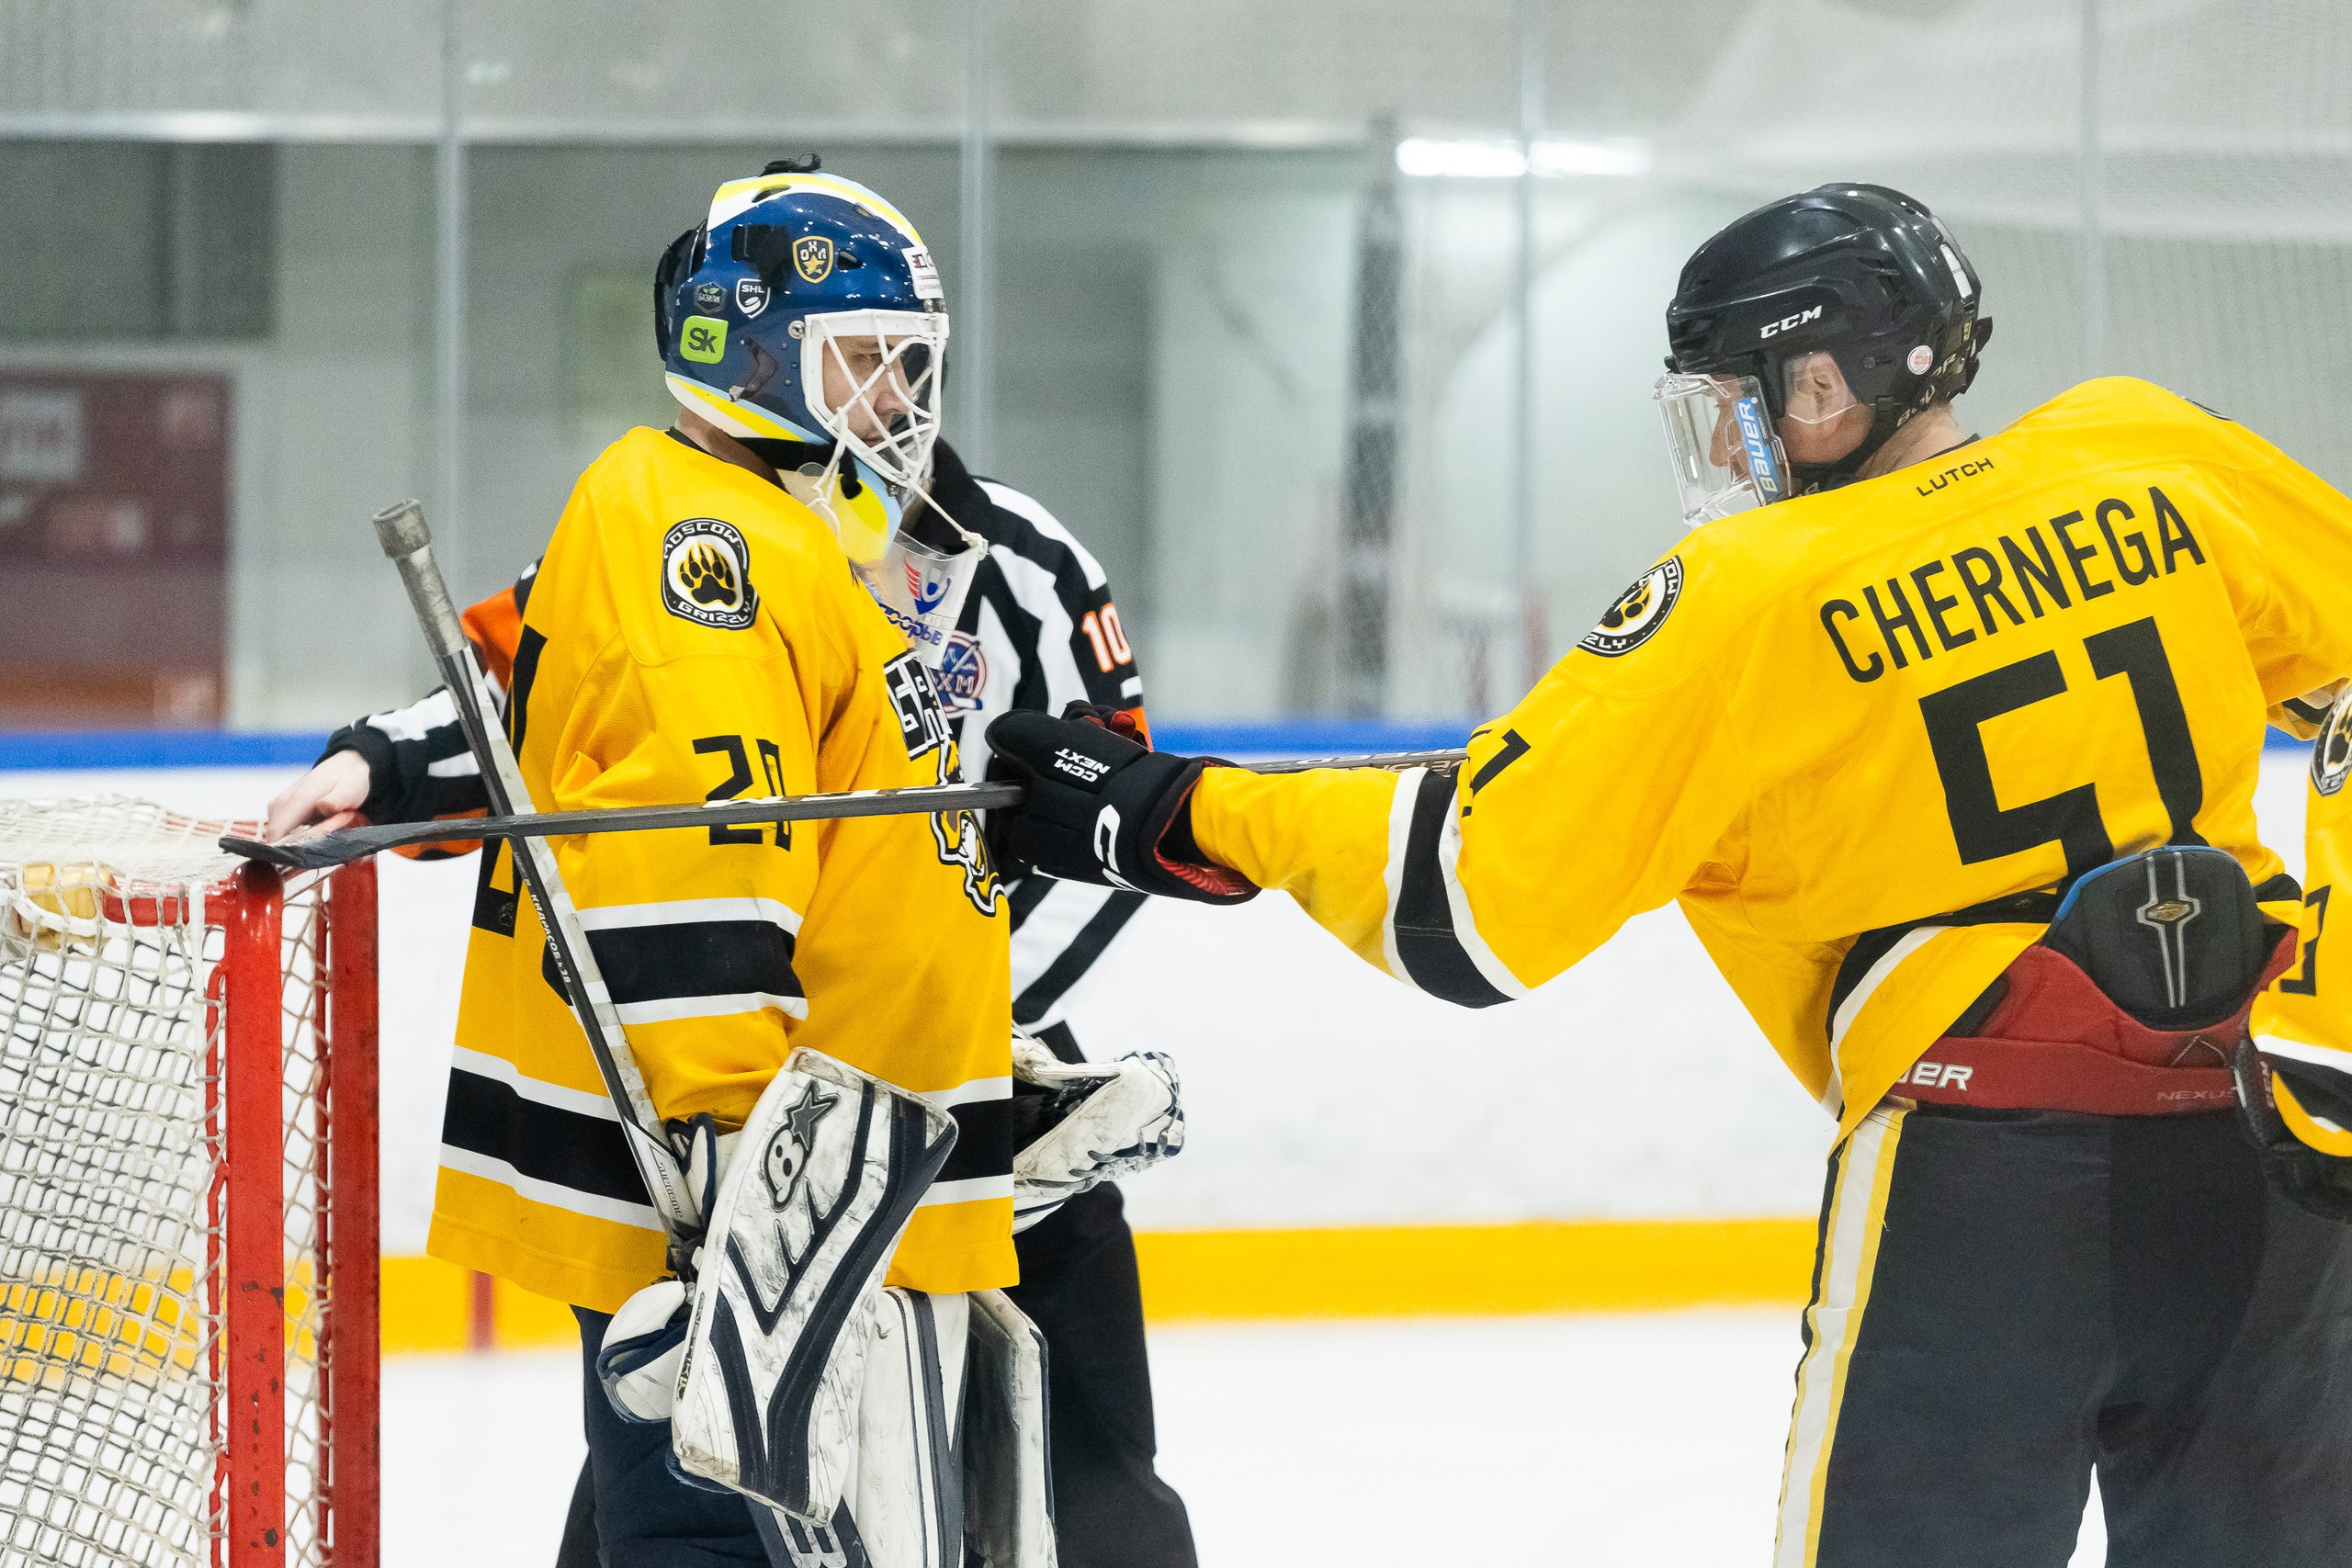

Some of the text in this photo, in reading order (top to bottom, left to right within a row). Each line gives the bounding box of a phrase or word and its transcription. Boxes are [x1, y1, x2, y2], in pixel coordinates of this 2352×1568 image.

[741, 284, 765, 294] SHL
[687, 327, 718, 354] Sk
[1759, 304, 1823, 340] CCM
[1737, 401, 1779, 493] BAUER
[1916, 457, 1995, 497] LUTCH
[1819, 486, 2207, 683] CHERNEGA
[1081, 603, 1132, 672] 10
[1053, 758, 1099, 783] CCM
[1054, 748, 1111, 774] NEXT
[1918, 616, 2209, 887] 51
